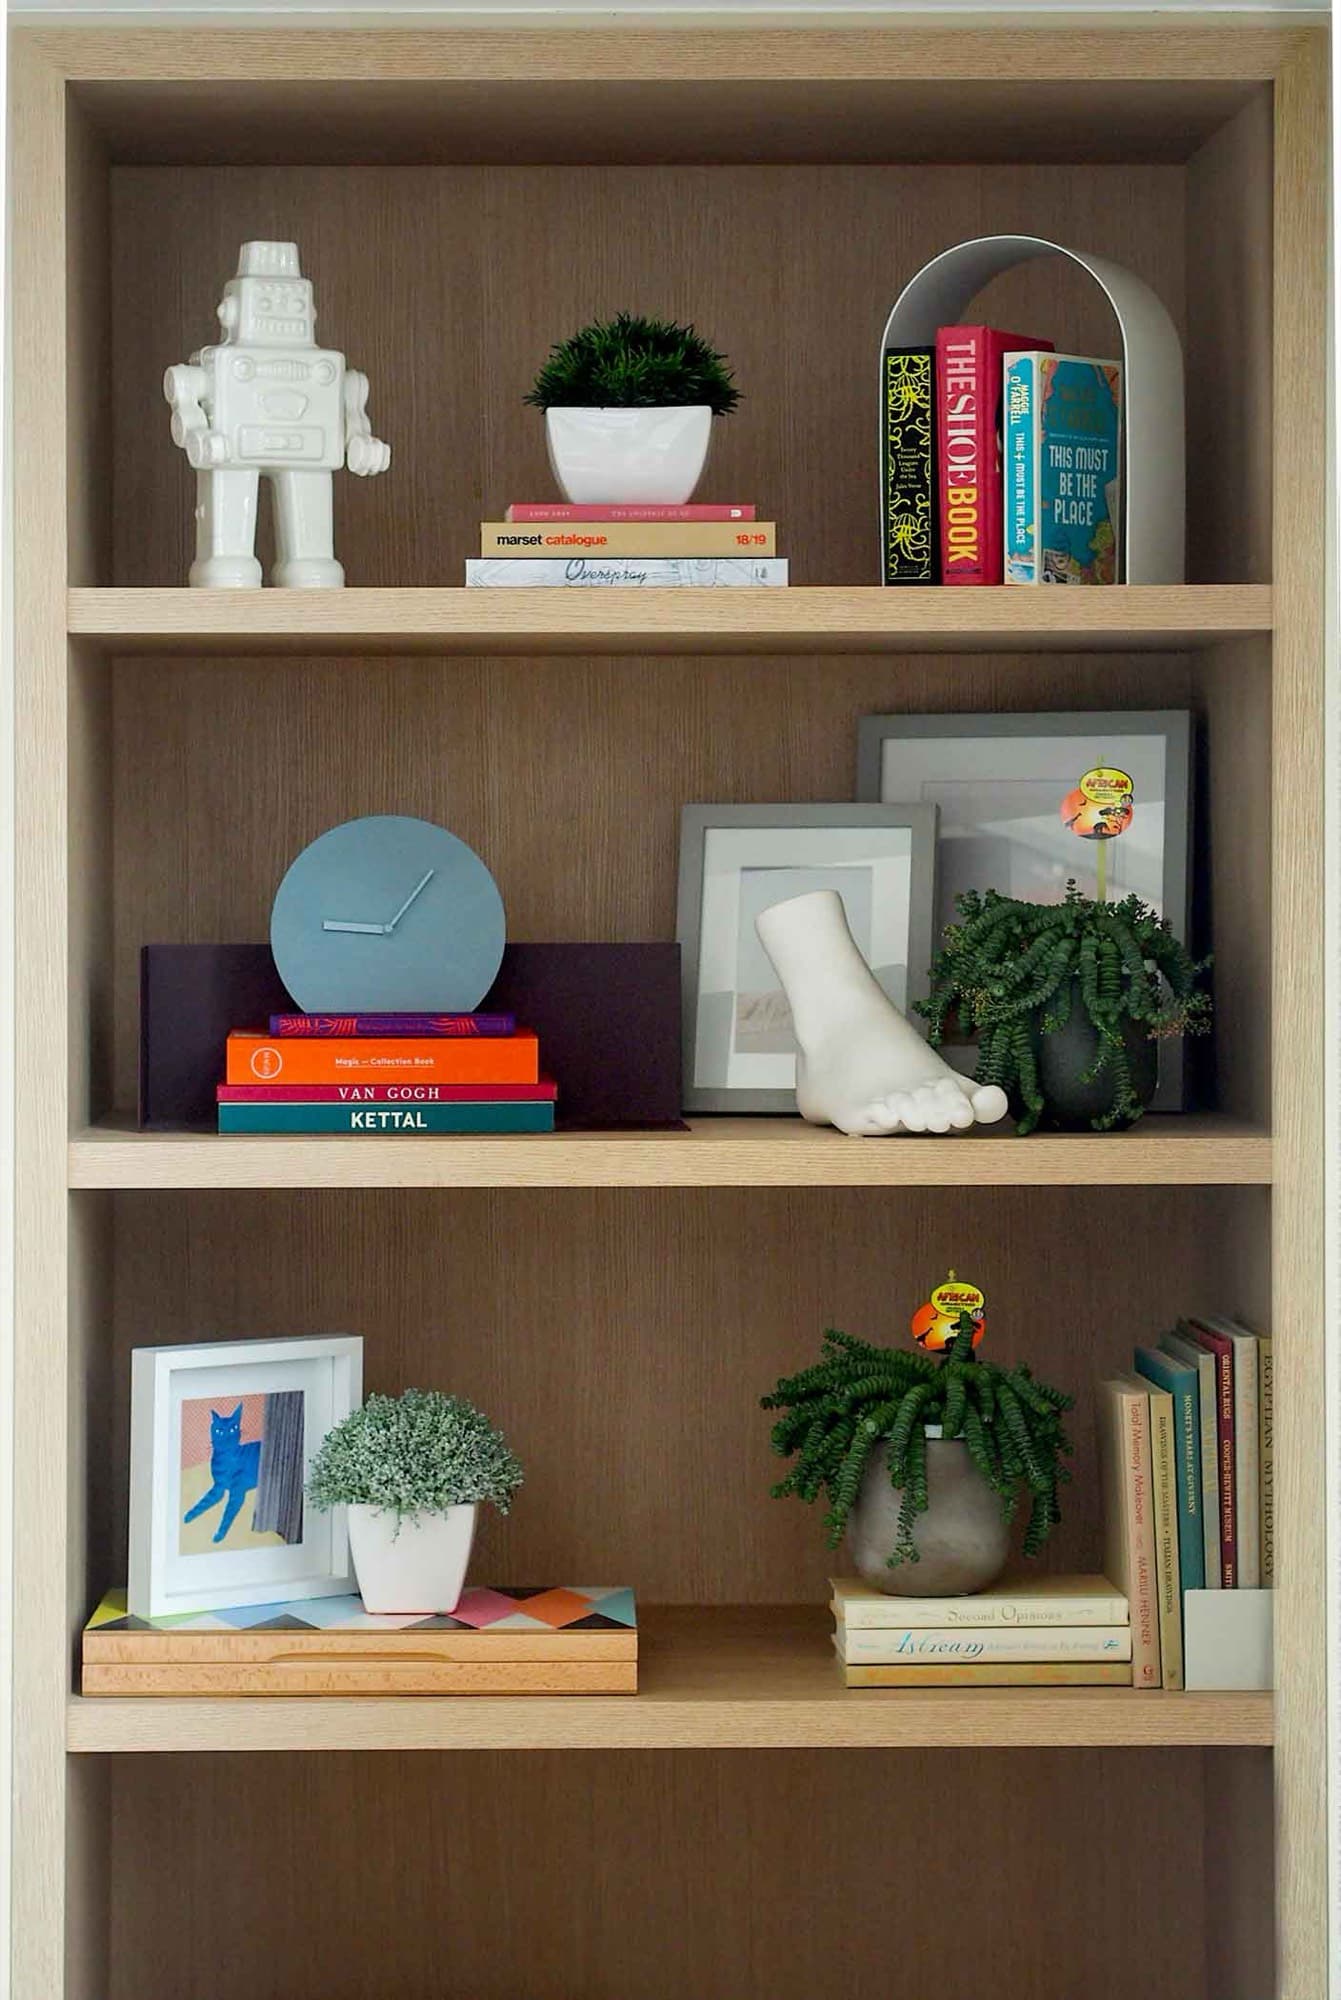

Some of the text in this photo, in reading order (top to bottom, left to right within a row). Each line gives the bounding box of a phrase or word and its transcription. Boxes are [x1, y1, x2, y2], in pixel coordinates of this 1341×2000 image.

[1010, 376, 1021, 426] O'FARRELL
[1020, 384, 1030, 415] MAGGIE
[1049, 445, 1109, 472] THIS MUST
[1015, 432, 1026, 544] THIS MUST BE THE PLACE
[1059, 472, 1097, 498] BE THE
[1054, 498, 1093, 526] PLACE
[497, 533, 767, 548] marset catalogue 18/19
[565, 559, 648, 584] Overspray
[1086, 778, 1128, 789] AFRICAN
[370, 1057, 411, 1066] Collection
[413, 1057, 435, 1065] Book
[339, 1087, 439, 1100] VAN GOGH
[351, 1111, 427, 1128] KETTAL
[937, 1292, 980, 1302] AFRICAN
[1222, 1354, 1231, 1397] ORIENTAL
[1223, 1398, 1231, 1420] RUGS
[1130, 1404, 1145, 1525] Total Memory Makeover
[1187, 1461, 1195, 1473] AT
[1224, 1507, 1233, 1542] MUSEUM
[1264, 1461, 1274, 1578] MYTHOLOGY
[947, 1605, 1062, 1623] Second Opinions
[1138, 1556, 1152, 1646] MARILU HENNER
